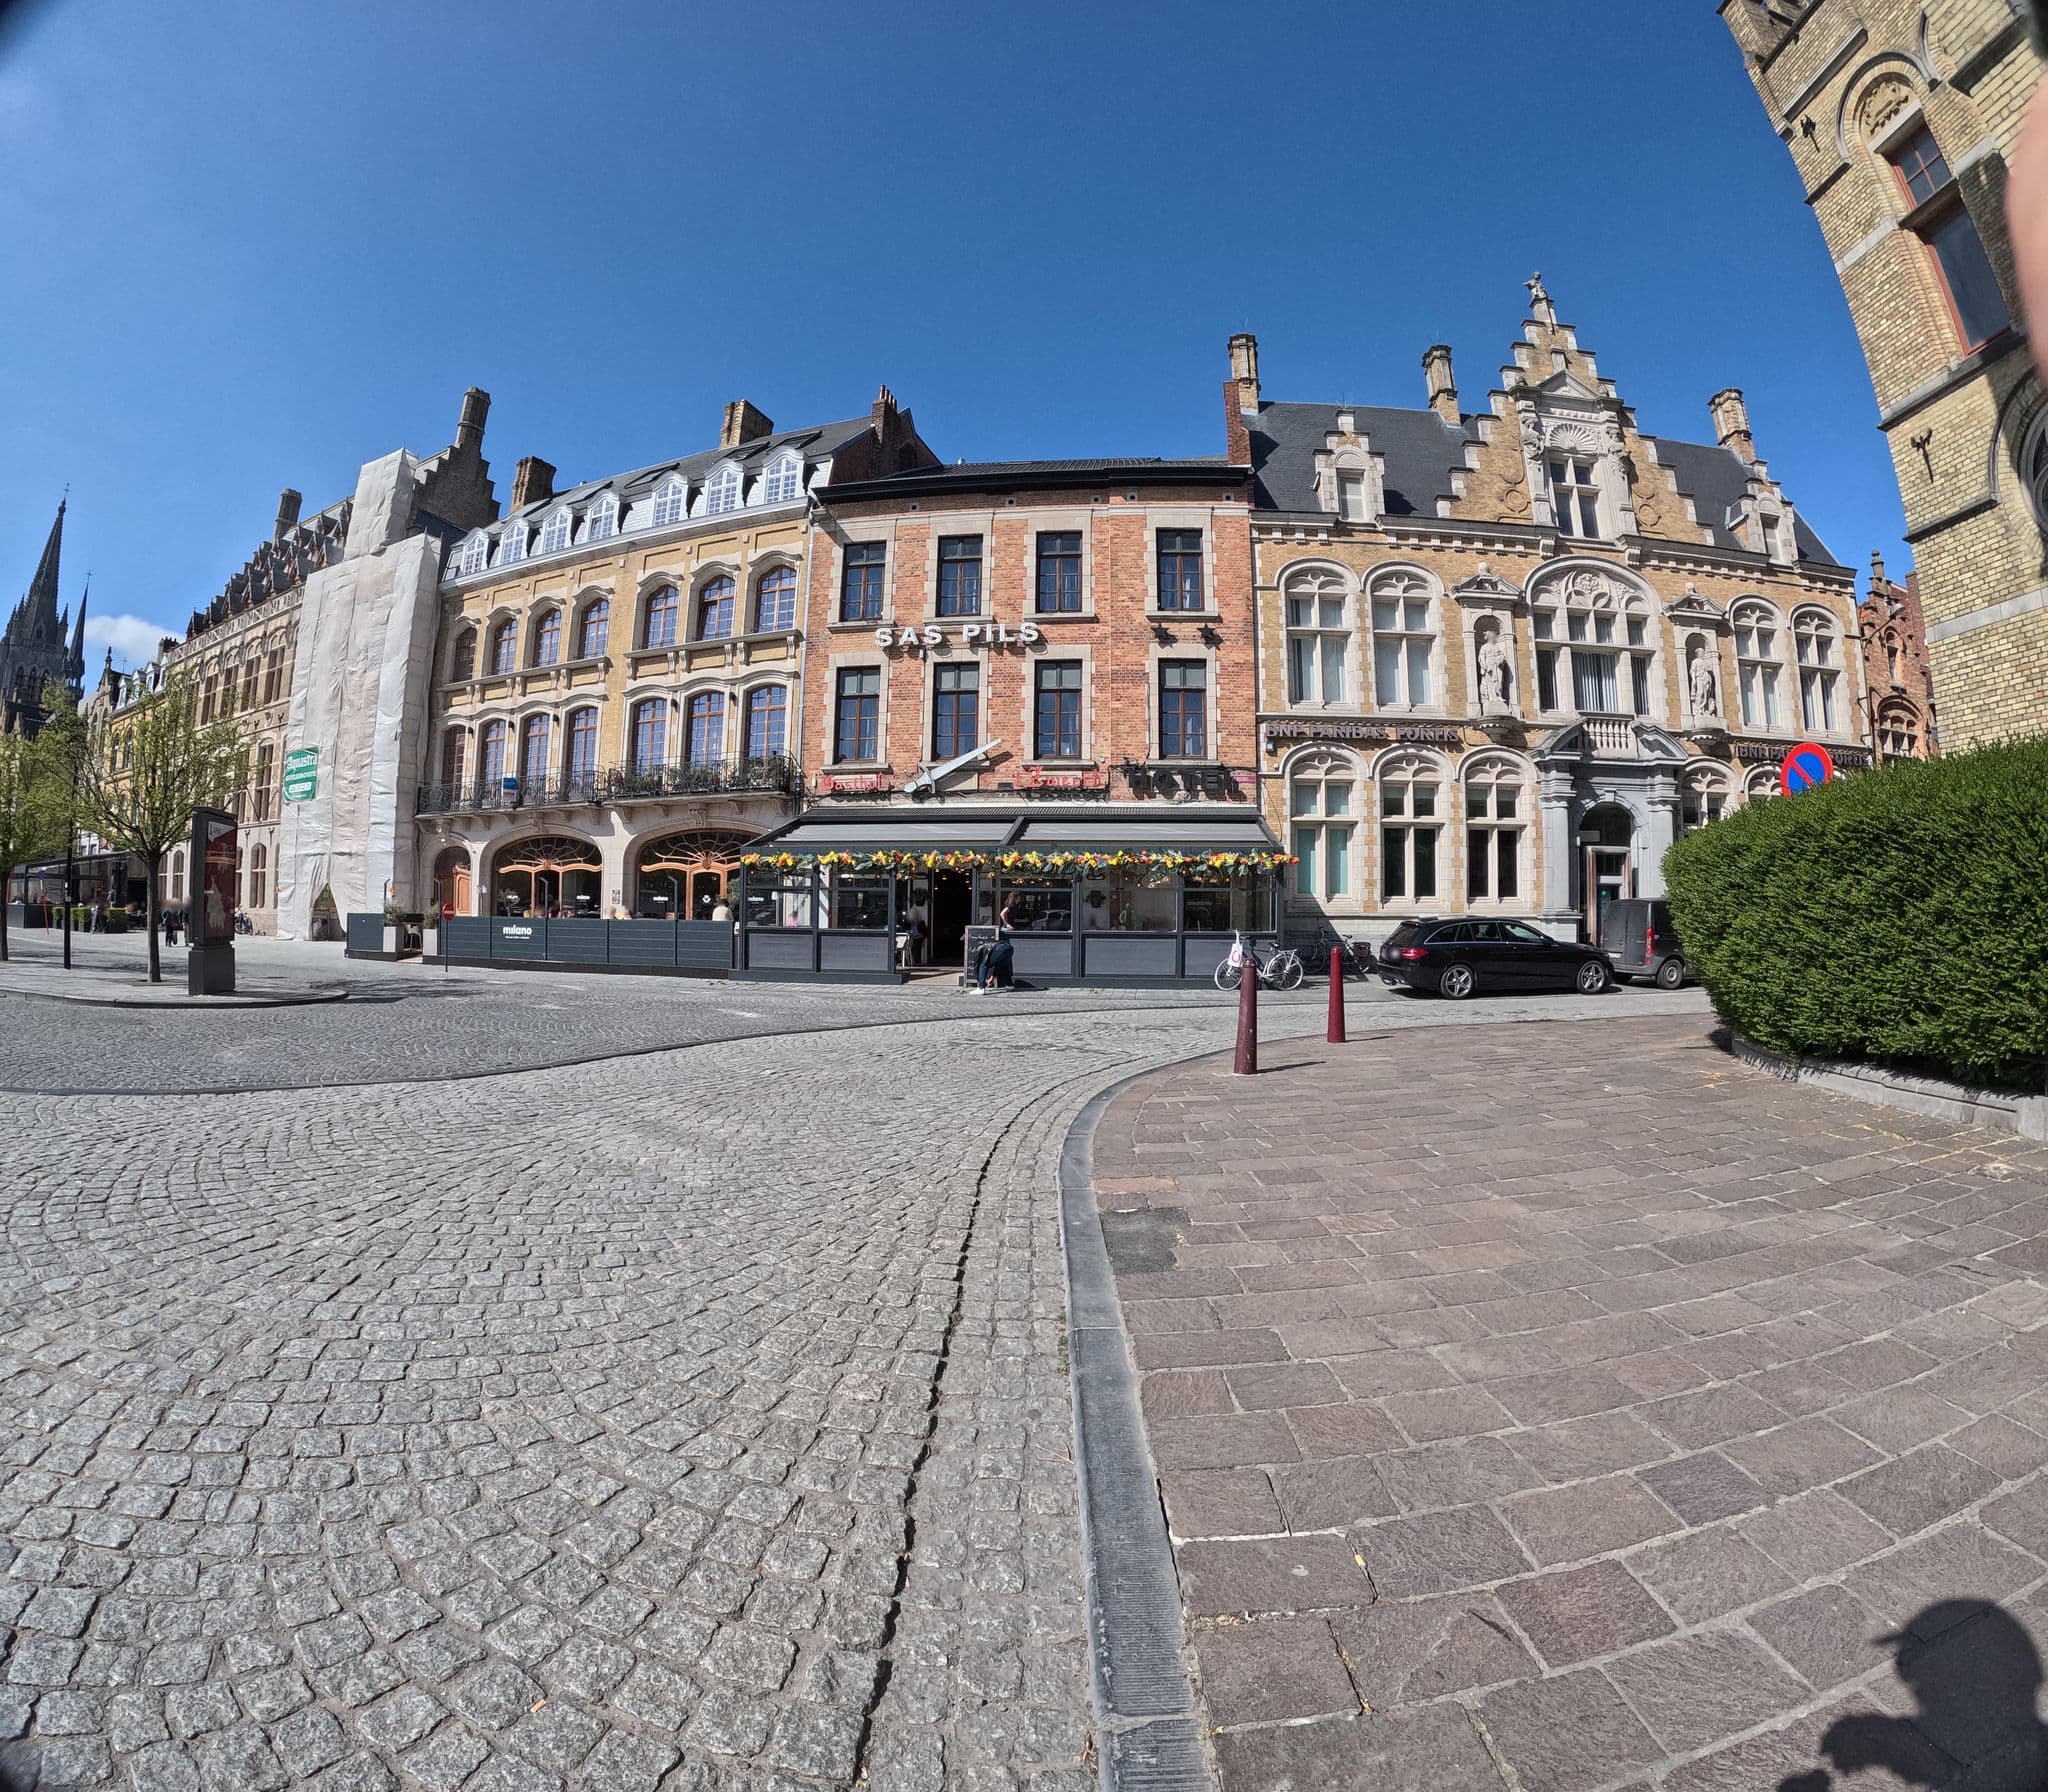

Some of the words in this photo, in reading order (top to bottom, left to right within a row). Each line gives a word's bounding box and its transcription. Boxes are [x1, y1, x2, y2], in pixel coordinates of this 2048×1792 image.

[874, 624, 943, 647] SAS
[962, 622, 1039, 643] PILS
[1266, 724, 1304, 738] BNP
[1309, 725, 1387, 740] PARIBAS
[1396, 727, 1459, 742] FORTIS
[1740, 746, 1768, 759] BNP
[1128, 764, 1240, 793] HOTEL
[502, 924, 533, 935] milano
